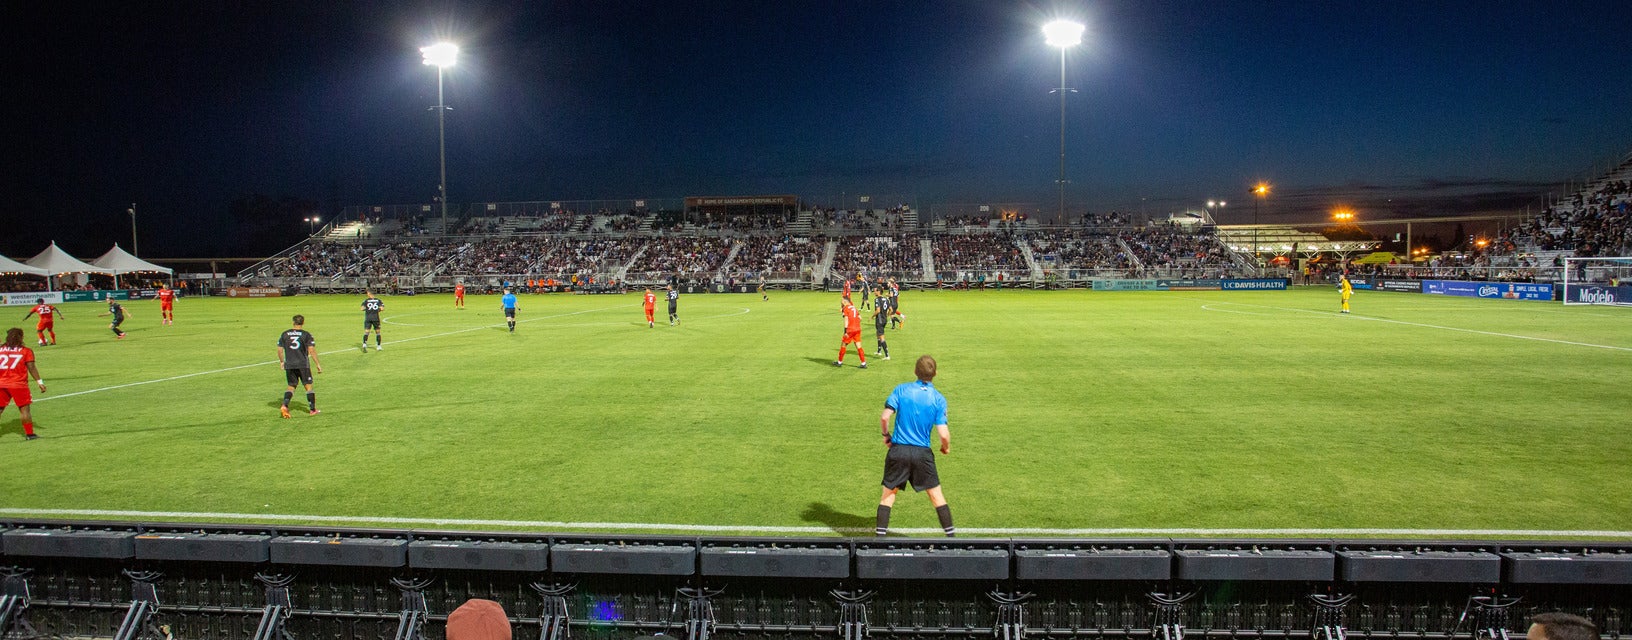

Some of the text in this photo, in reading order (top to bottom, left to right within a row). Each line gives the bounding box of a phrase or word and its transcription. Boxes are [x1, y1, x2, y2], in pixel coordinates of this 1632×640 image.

[1580, 288, 1614, 304] Modelo
[38, 306, 51, 315] 25
[366, 302, 379, 311] 96
[289, 336, 301, 350] 3
[0, 353, 24, 370] 27
